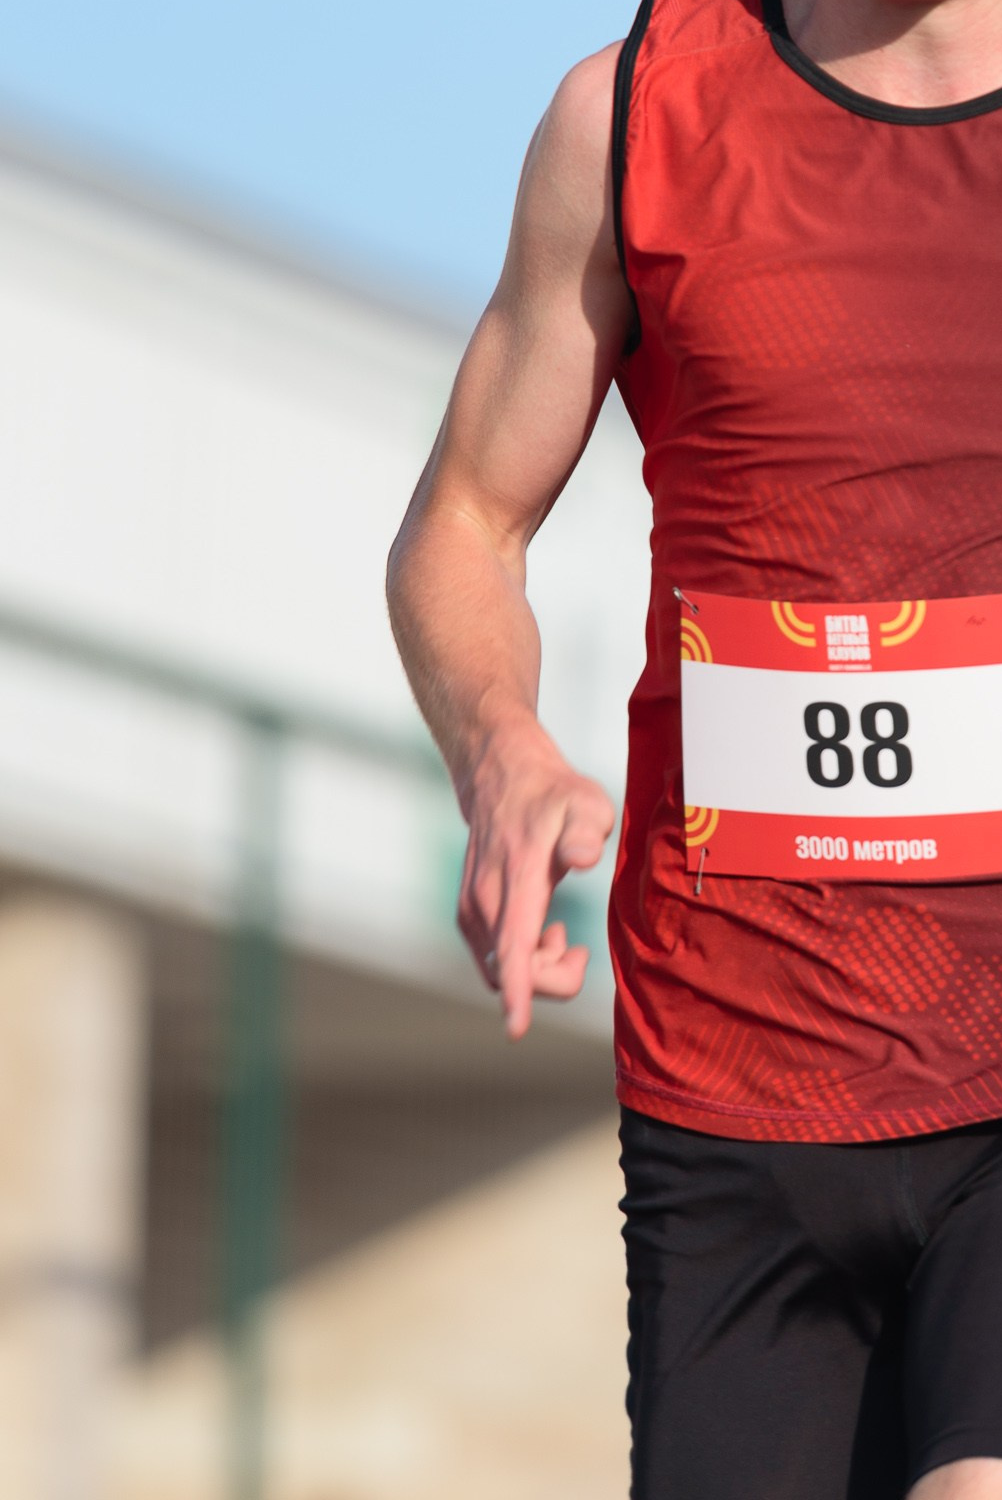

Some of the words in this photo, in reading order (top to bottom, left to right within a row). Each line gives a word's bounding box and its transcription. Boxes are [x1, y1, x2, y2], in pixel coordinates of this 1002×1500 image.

[803, 701, 913, 789] 88
[795, 835, 849, 861] 3000
[853, 838, 938, 865] метров
